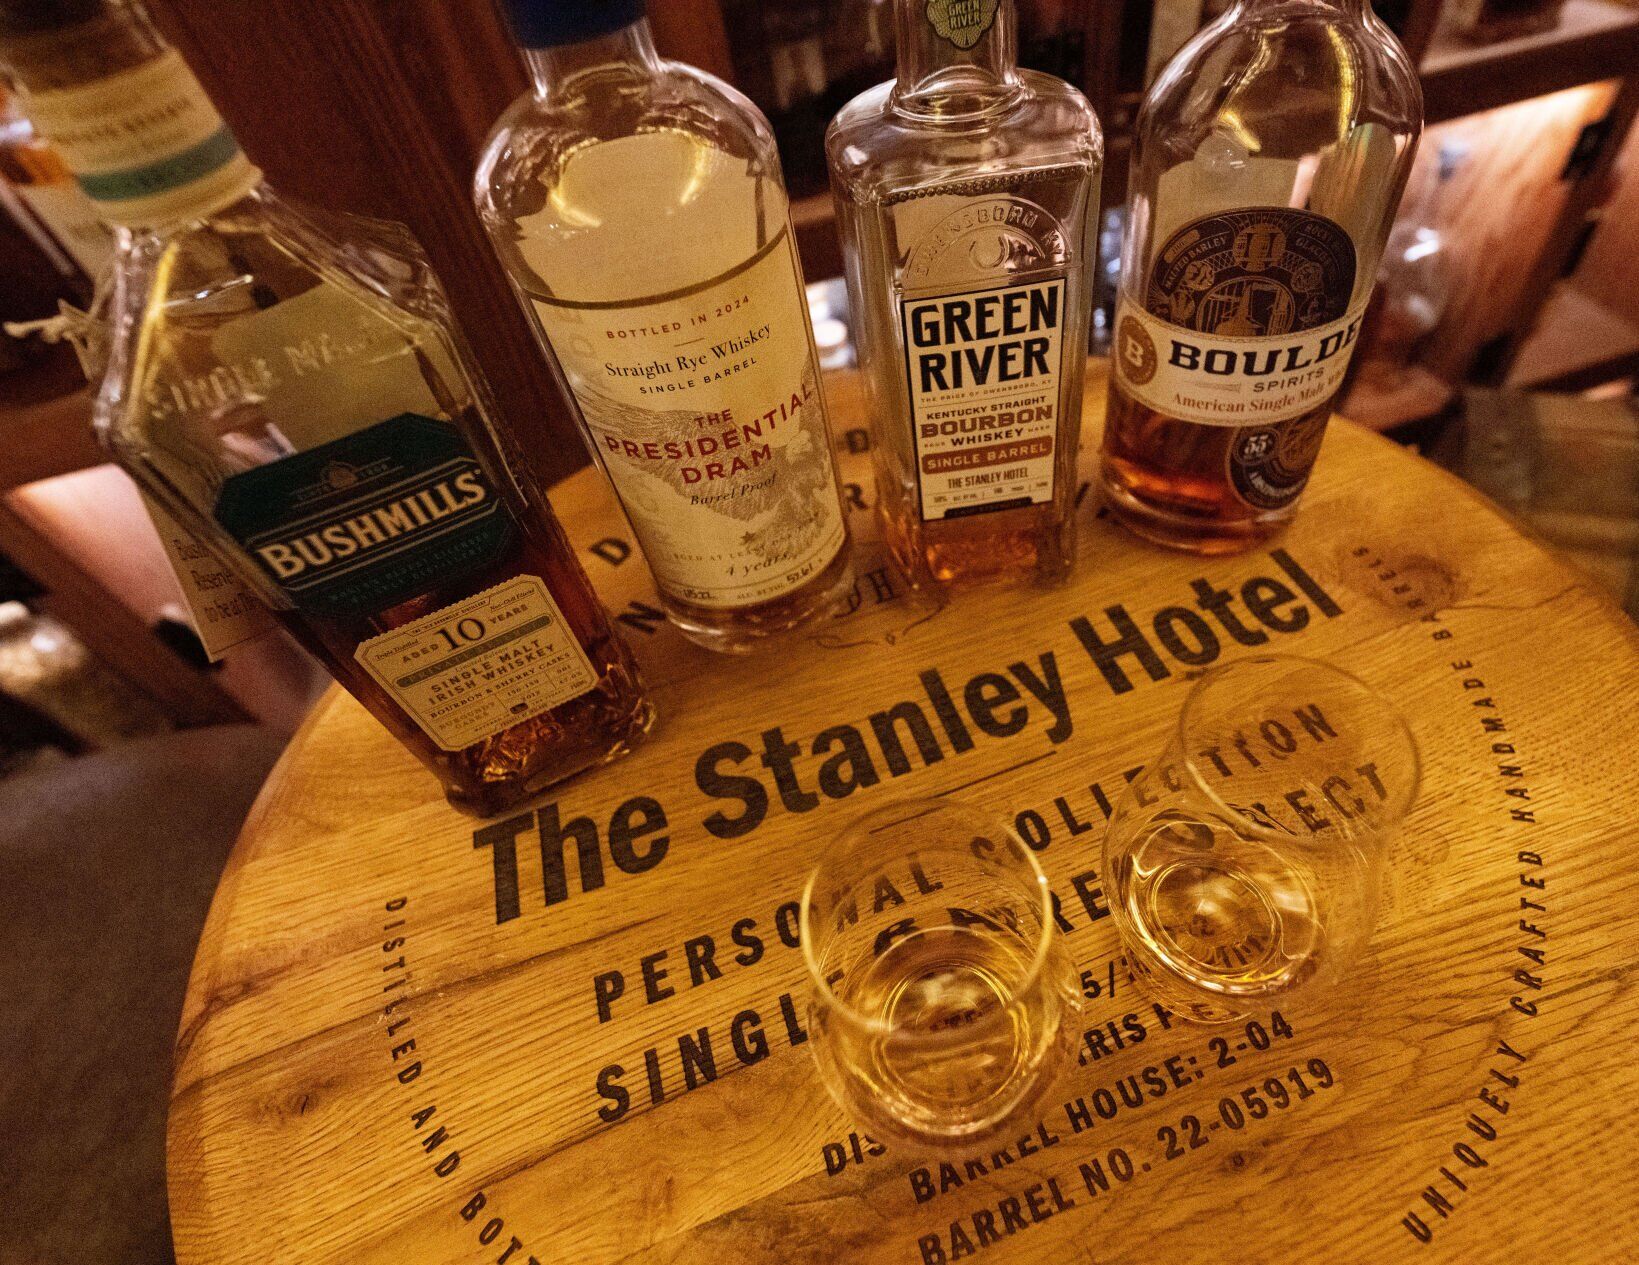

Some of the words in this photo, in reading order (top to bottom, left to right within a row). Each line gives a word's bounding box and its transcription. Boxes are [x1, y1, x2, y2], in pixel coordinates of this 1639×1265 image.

[950, 13, 982, 29] RIVER
[606, 320, 682, 339] BOTTLED
[690, 313, 708, 327] IN
[716, 294, 751, 318] 2024
[911, 285, 1058, 348] GREEN
[604, 356, 673, 381] Straight
[677, 350, 708, 372] Rye
[710, 321, 772, 360] Whiskey
[639, 378, 697, 395] SINGLE
[703, 356, 759, 385] BARREL
[919, 337, 1050, 393] RIVER
[1253, 366, 1325, 393] SPIRITS
[604, 383, 812, 461] PRESIDENTIAL
[694, 408, 735, 429] THE
[920, 404, 1054, 439] BOURBON
[926, 407, 988, 420] KENTUCKY
[990, 395, 1047, 412] STRAIGHT
[1175, 392, 1246, 413] American
[1249, 394, 1297, 413] Single
[681, 443, 773, 486] DRAM
[927, 454, 981, 470] SINGLE
[987, 442, 1048, 461] BARREL
[951, 427, 1025, 447] WHISKEY
[690, 487, 737, 507] Barrel
[738, 470, 778, 498] Proof
[948, 477, 963, 489] THE
[964, 470, 1001, 487] STANLEY
[1003, 466, 1029, 481] HOTEL
[257, 469, 487, 580] BUSHMILLS
[401, 641, 439, 664] AGED
[432, 617, 487, 652] 10
[488, 602, 528, 625] YEARS
[428, 678, 476, 706] IRISH
[481, 643, 555, 682] WHISKEY
[429, 691, 482, 719] BOURBON
[494, 667, 536, 690] SHERRY
[537, 651, 570, 670] CASKS
[430, 660, 492, 693] SINGLE
[498, 638, 540, 663] MALT
[473, 796, 670, 925] The
[695, 651, 1074, 839] Stanley
[1069, 549, 1345, 696] Hotel
[1452, 659, 1537, 824] HANDMADE
[594, 850, 945, 1024] PERSONAL
[1509, 850, 1547, 1017] CRAFTED
[382, 896, 422, 1085] DISTILLED
[411, 1104, 461, 1178] AND
[596, 970, 845, 1124] SINGL
[908, 1117, 1060, 1205] BARREL
[1063, 1055, 1205, 1135] HOUSE:
[1208, 1010, 1294, 1070] 2-04
[917, 1177, 1077, 1265] BARREL
[1078, 1146, 1152, 1198] NO.
[1156, 1056, 1335, 1161] 22-05919
[1402, 1040, 1528, 1244] UNIQUELY
